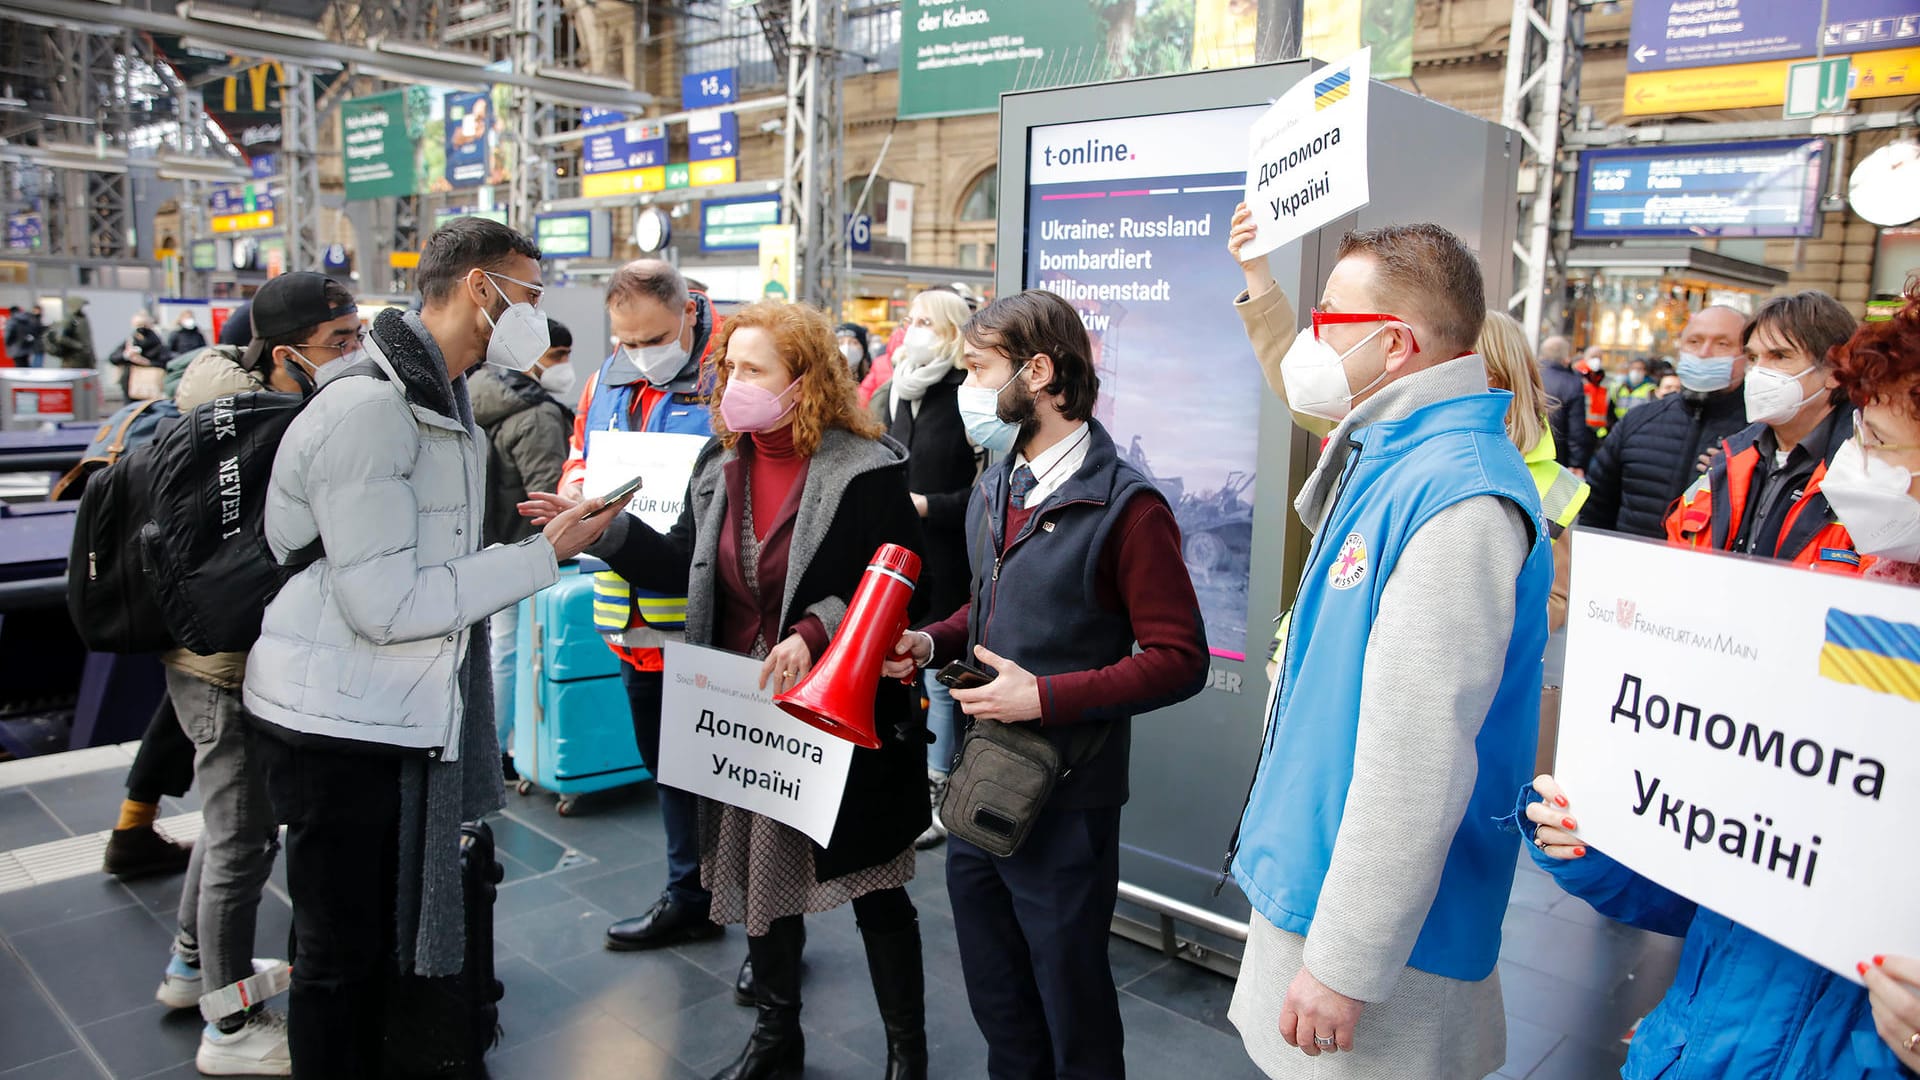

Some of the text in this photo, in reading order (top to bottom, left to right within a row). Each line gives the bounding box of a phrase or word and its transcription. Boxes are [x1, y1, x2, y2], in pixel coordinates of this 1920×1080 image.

[917, 5, 990, 32] der Kakao.
[1044, 139, 1135, 166] t-online.
[1258, 127, 1341, 192] Допомога
[1270, 171, 1330, 221] Україні
[1041, 213, 1211, 241] Ukraine: Russland
[1040, 248, 1152, 271] bombardiert
[1039, 279, 1170, 301] Millionenstadt
[1079, 309, 1110, 331] kiw
[213, 396, 237, 441] BACK
[219, 456, 241, 525] NEVER
[632, 496, 657, 512] FÜR
[695, 709, 823, 765] Допомога
[1610, 673, 1886, 801] Допомога
[712, 753, 801, 801] Україні
[1633, 768, 1822, 887] Україні
